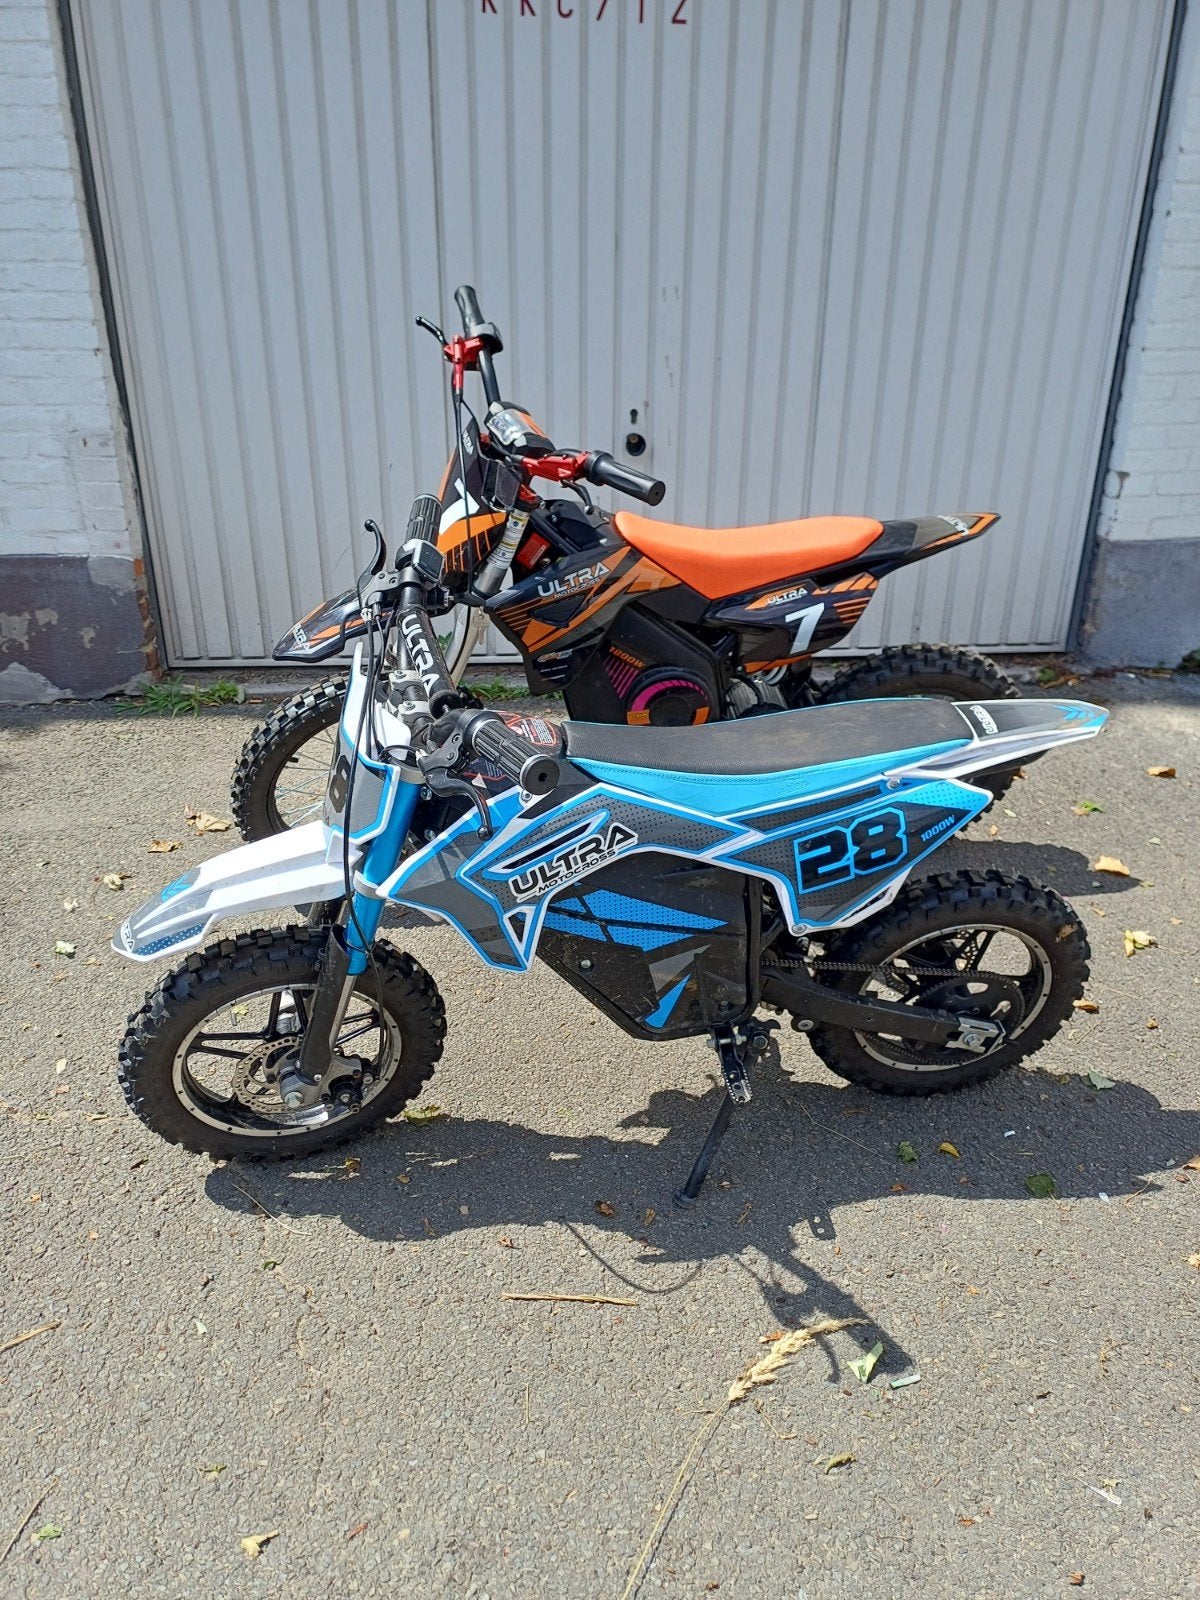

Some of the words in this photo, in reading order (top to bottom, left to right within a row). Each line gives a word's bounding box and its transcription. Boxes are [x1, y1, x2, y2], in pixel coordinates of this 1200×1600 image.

[538, 562, 610, 597] ULTRA
[554, 578, 601, 599] MOTOCROSS
[767, 587, 808, 604] ULTRA
[785, 602, 825, 655] 7
[401, 614, 439, 698] ULTRA
[608, 646, 646, 668] 1800W
[920, 814, 956, 843] 1000W
[510, 825, 638, 894] ULTRA
[794, 806, 907, 894] 28
[537, 850, 617, 892] MOTOCROSS
